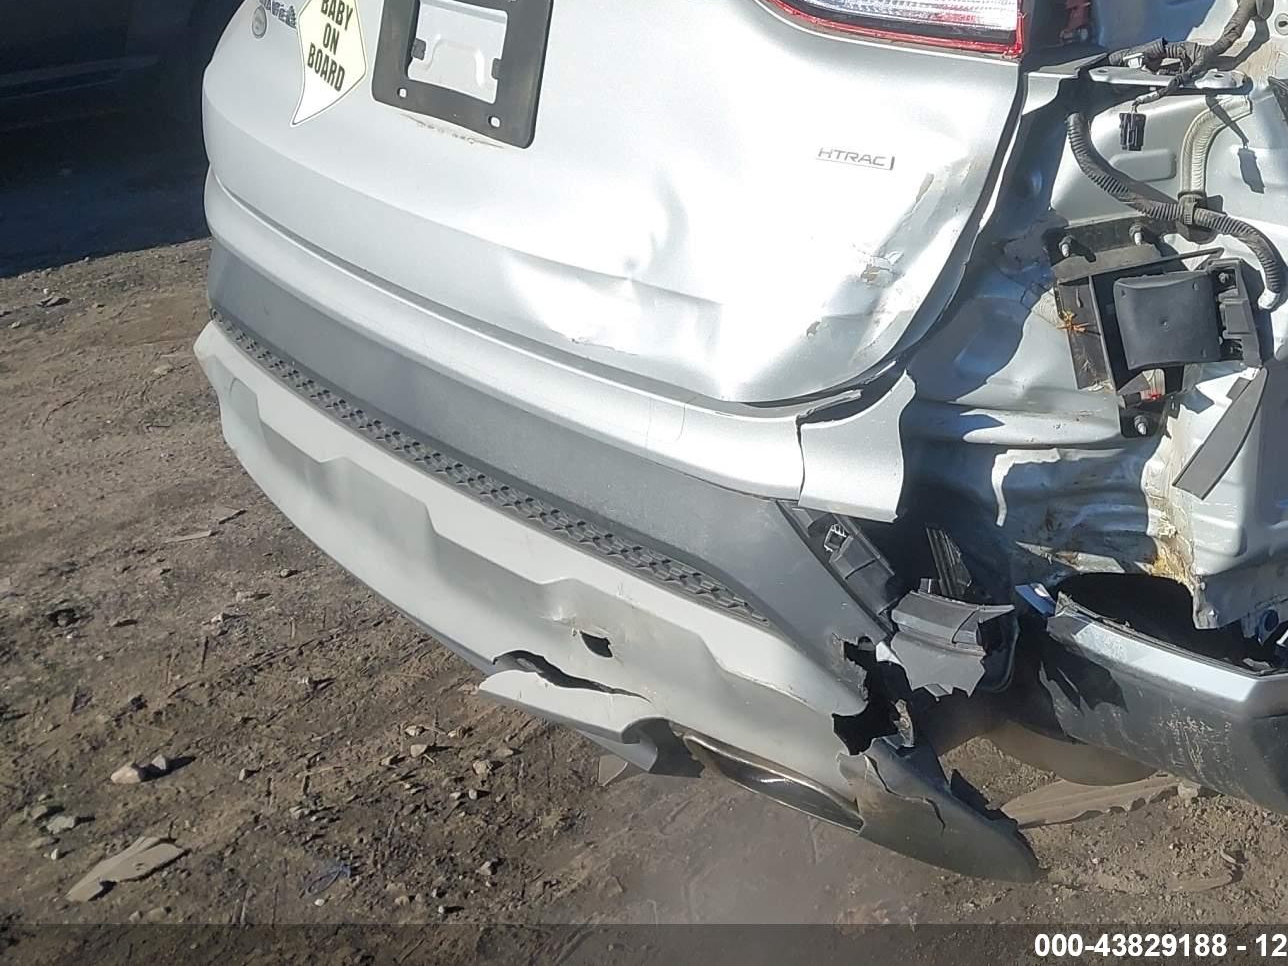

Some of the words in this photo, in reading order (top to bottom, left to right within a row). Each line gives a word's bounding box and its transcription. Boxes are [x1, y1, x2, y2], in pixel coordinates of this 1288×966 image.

[322, 22, 340, 55] ON
[307, 42, 345, 92] BOARD
[817, 147, 887, 167] HTRAC
